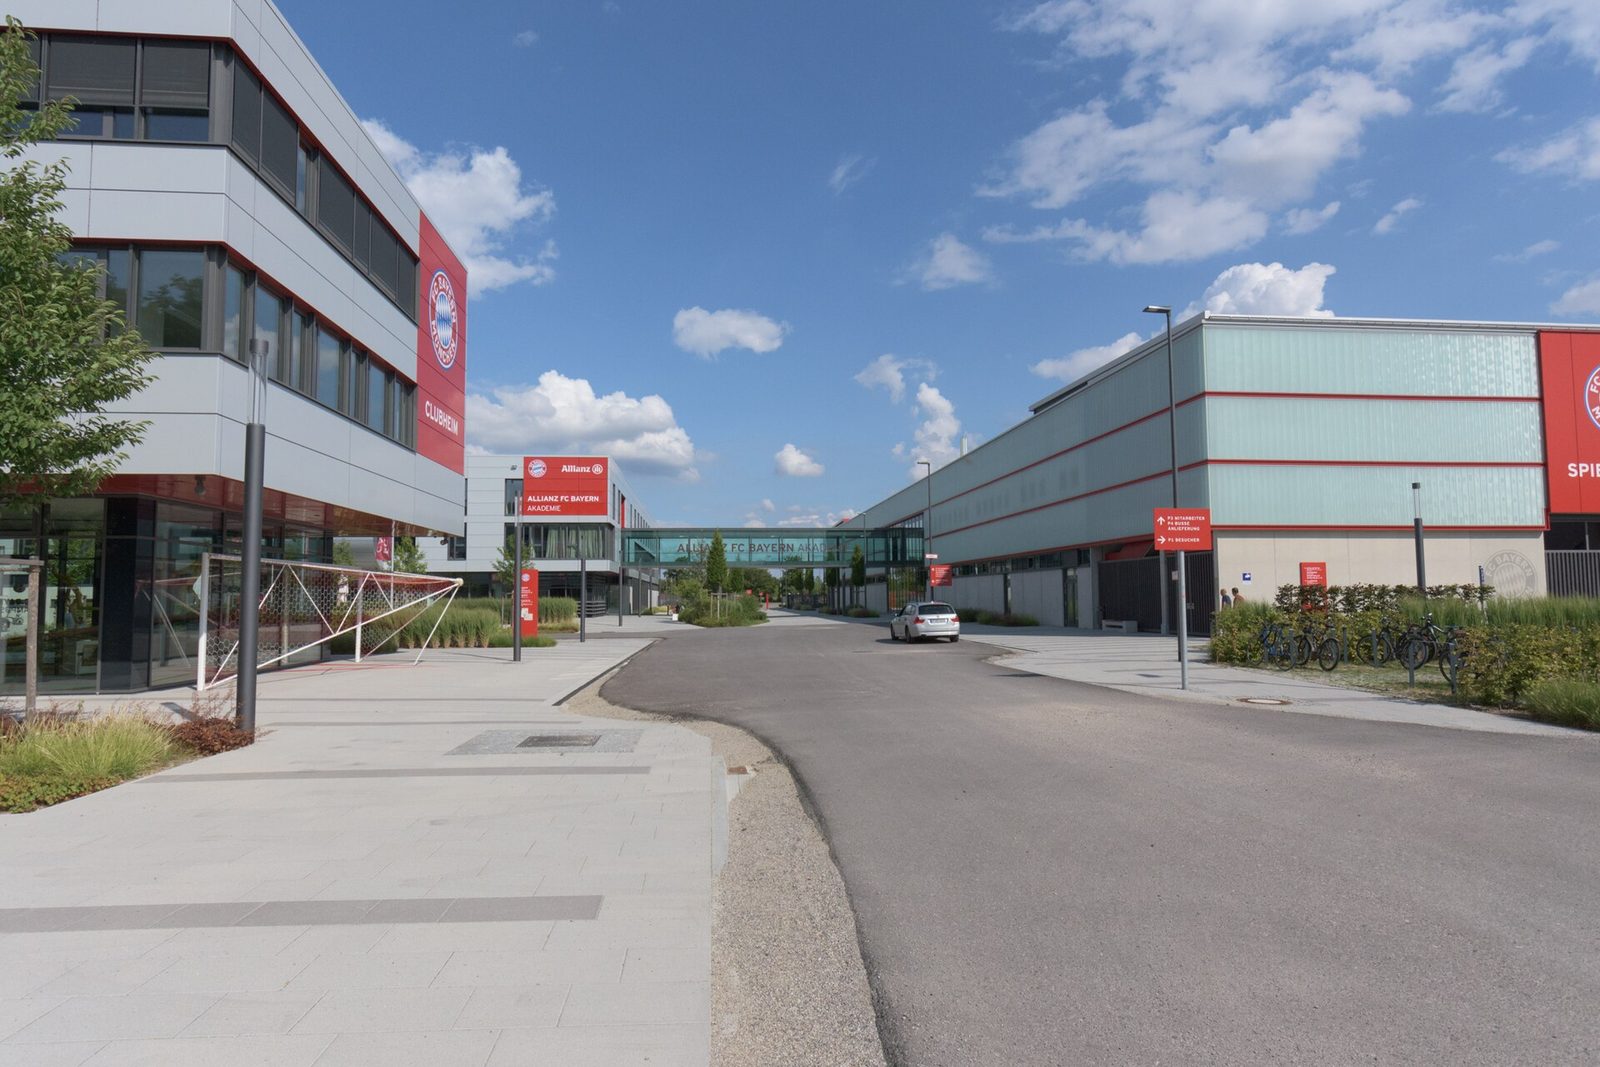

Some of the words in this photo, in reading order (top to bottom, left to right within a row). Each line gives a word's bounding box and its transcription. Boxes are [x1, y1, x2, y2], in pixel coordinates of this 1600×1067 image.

[425, 400, 459, 436] CLUBHEIM
[561, 464, 591, 473] Allianz
[677, 543, 728, 553] ALLIAZ
[731, 543, 745, 553] FC
[749, 543, 795, 553] BAYERN
[1495, 553, 1533, 577] BAYERN
